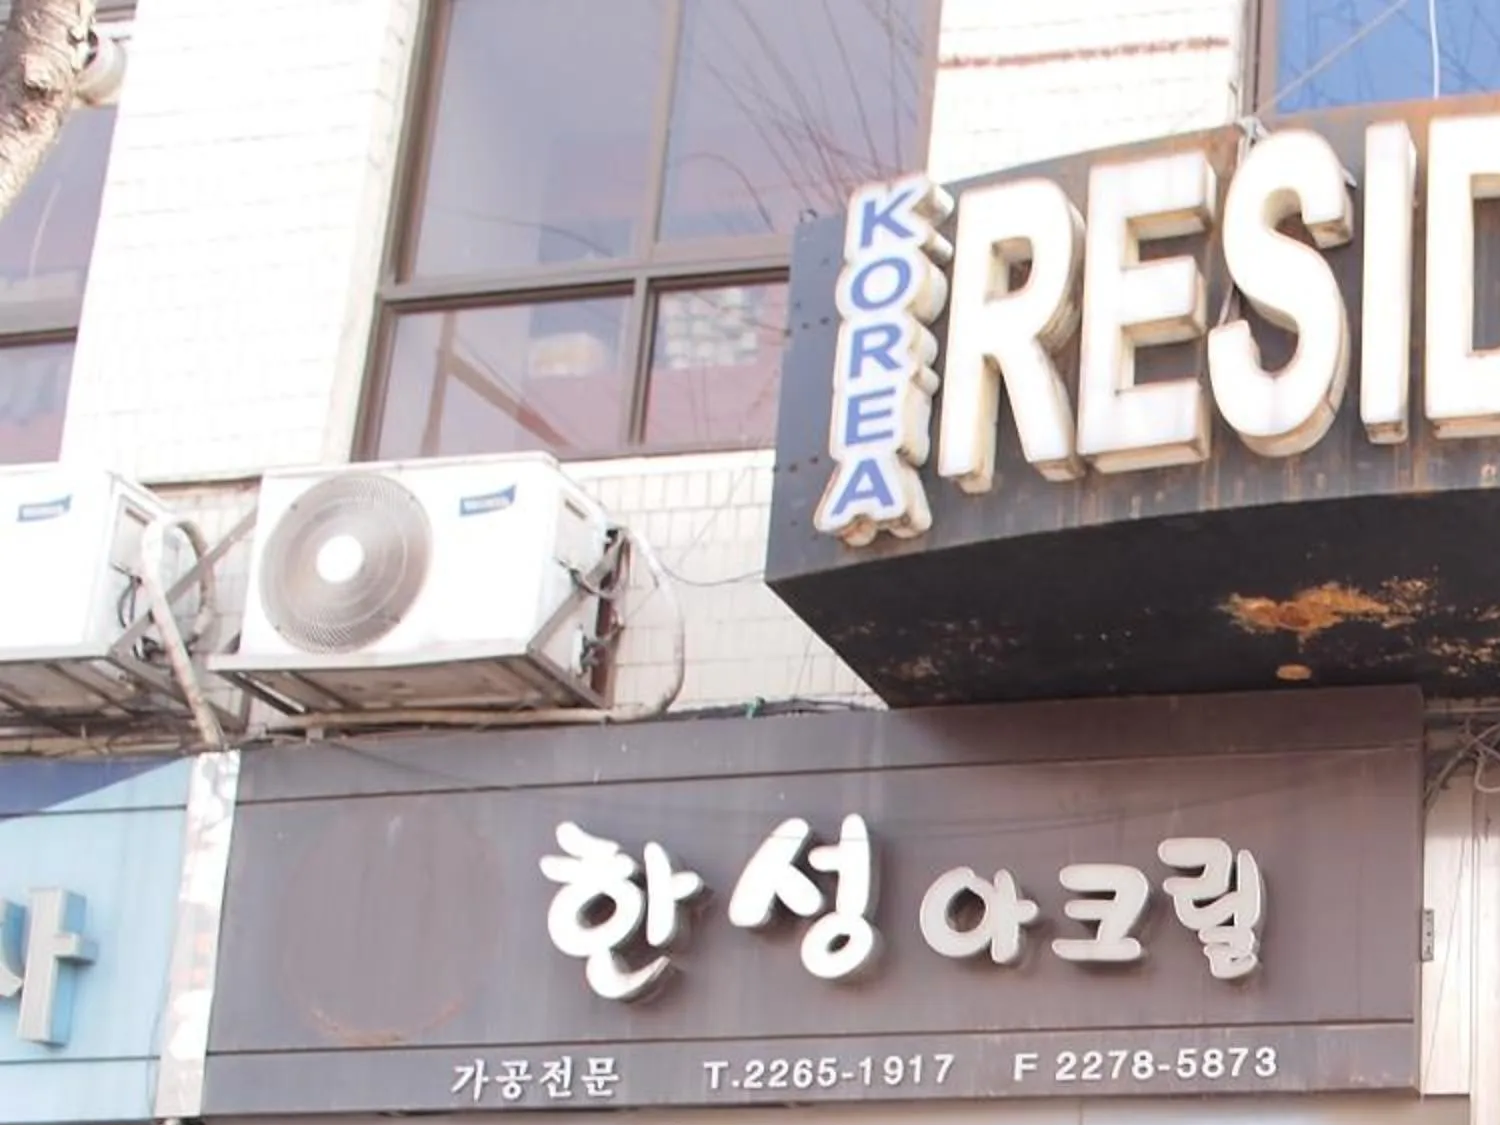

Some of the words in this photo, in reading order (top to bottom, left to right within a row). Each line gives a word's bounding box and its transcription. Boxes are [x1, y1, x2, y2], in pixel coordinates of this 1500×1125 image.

[828, 184, 930, 524] KOREA
[540, 813, 880, 1000] 한성
[920, 837, 1266, 980] 아크릴
[451, 1056, 620, 1101] 가공전문
[704, 1053, 956, 1089] T.2265-1917
[1014, 1053, 1038, 1081] F
[1055, 1047, 1278, 1081] 2278-5873
